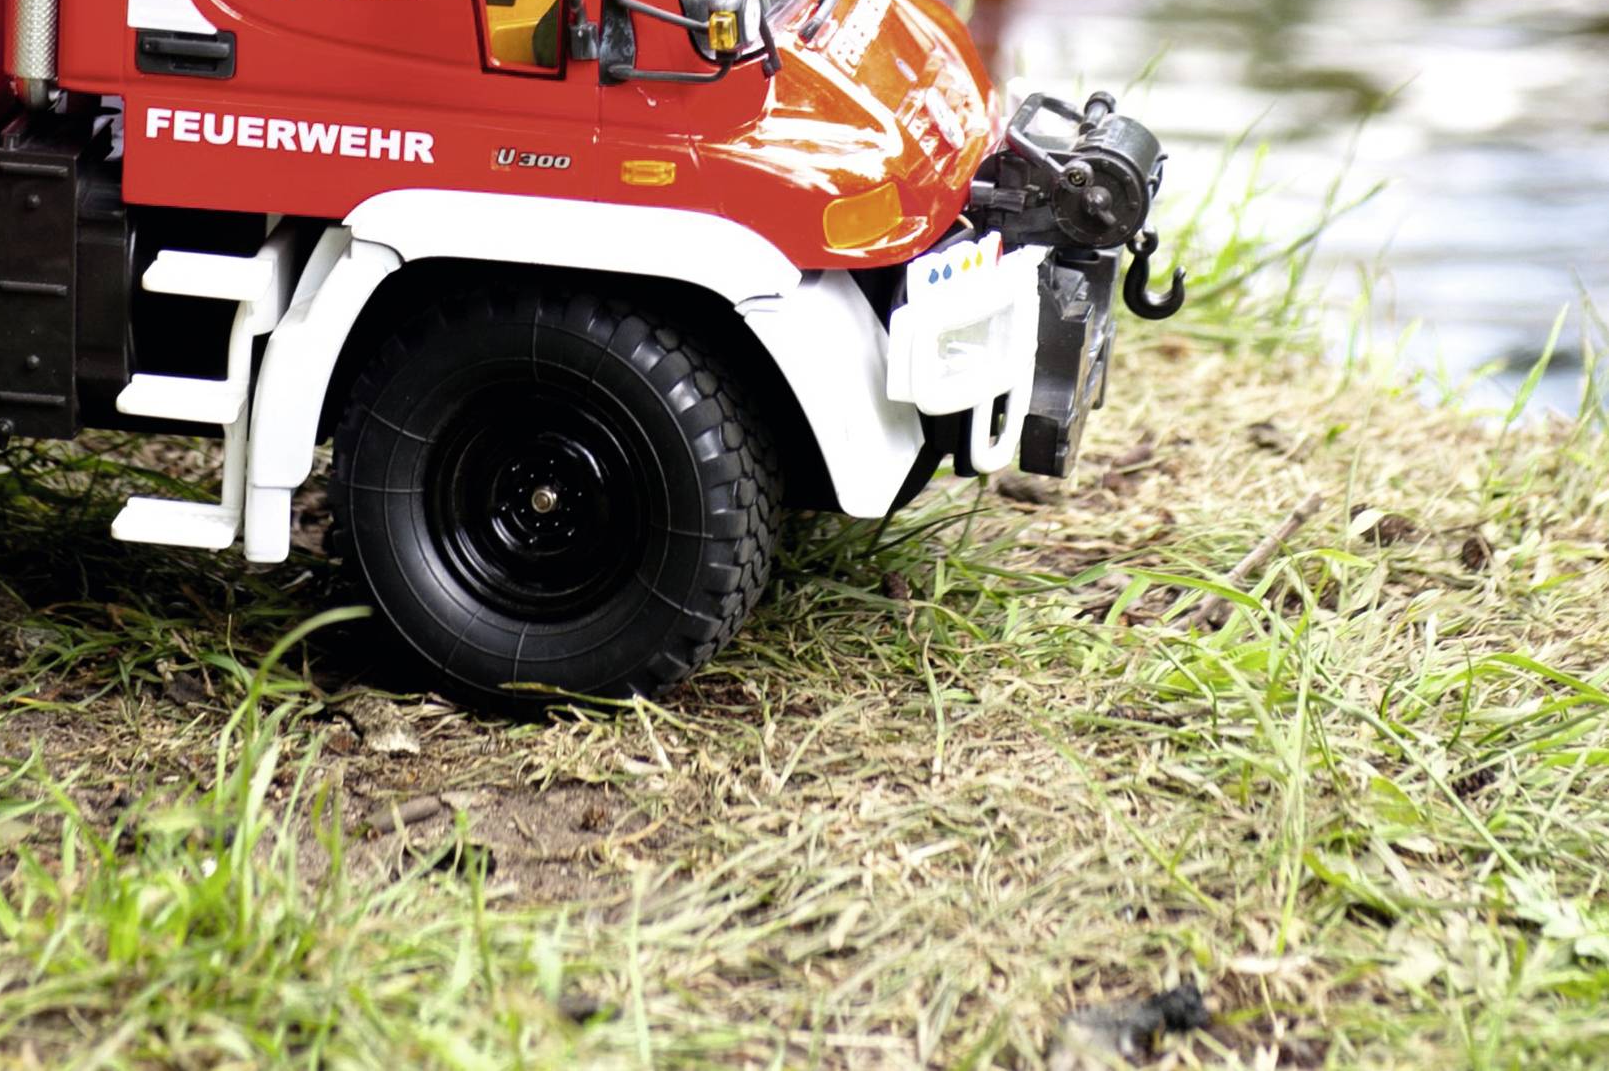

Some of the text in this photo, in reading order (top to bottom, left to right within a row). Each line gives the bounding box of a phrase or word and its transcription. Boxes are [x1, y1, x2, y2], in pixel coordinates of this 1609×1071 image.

[145, 107, 435, 165] FEUERWEHR
[496, 147, 572, 170] U 300
